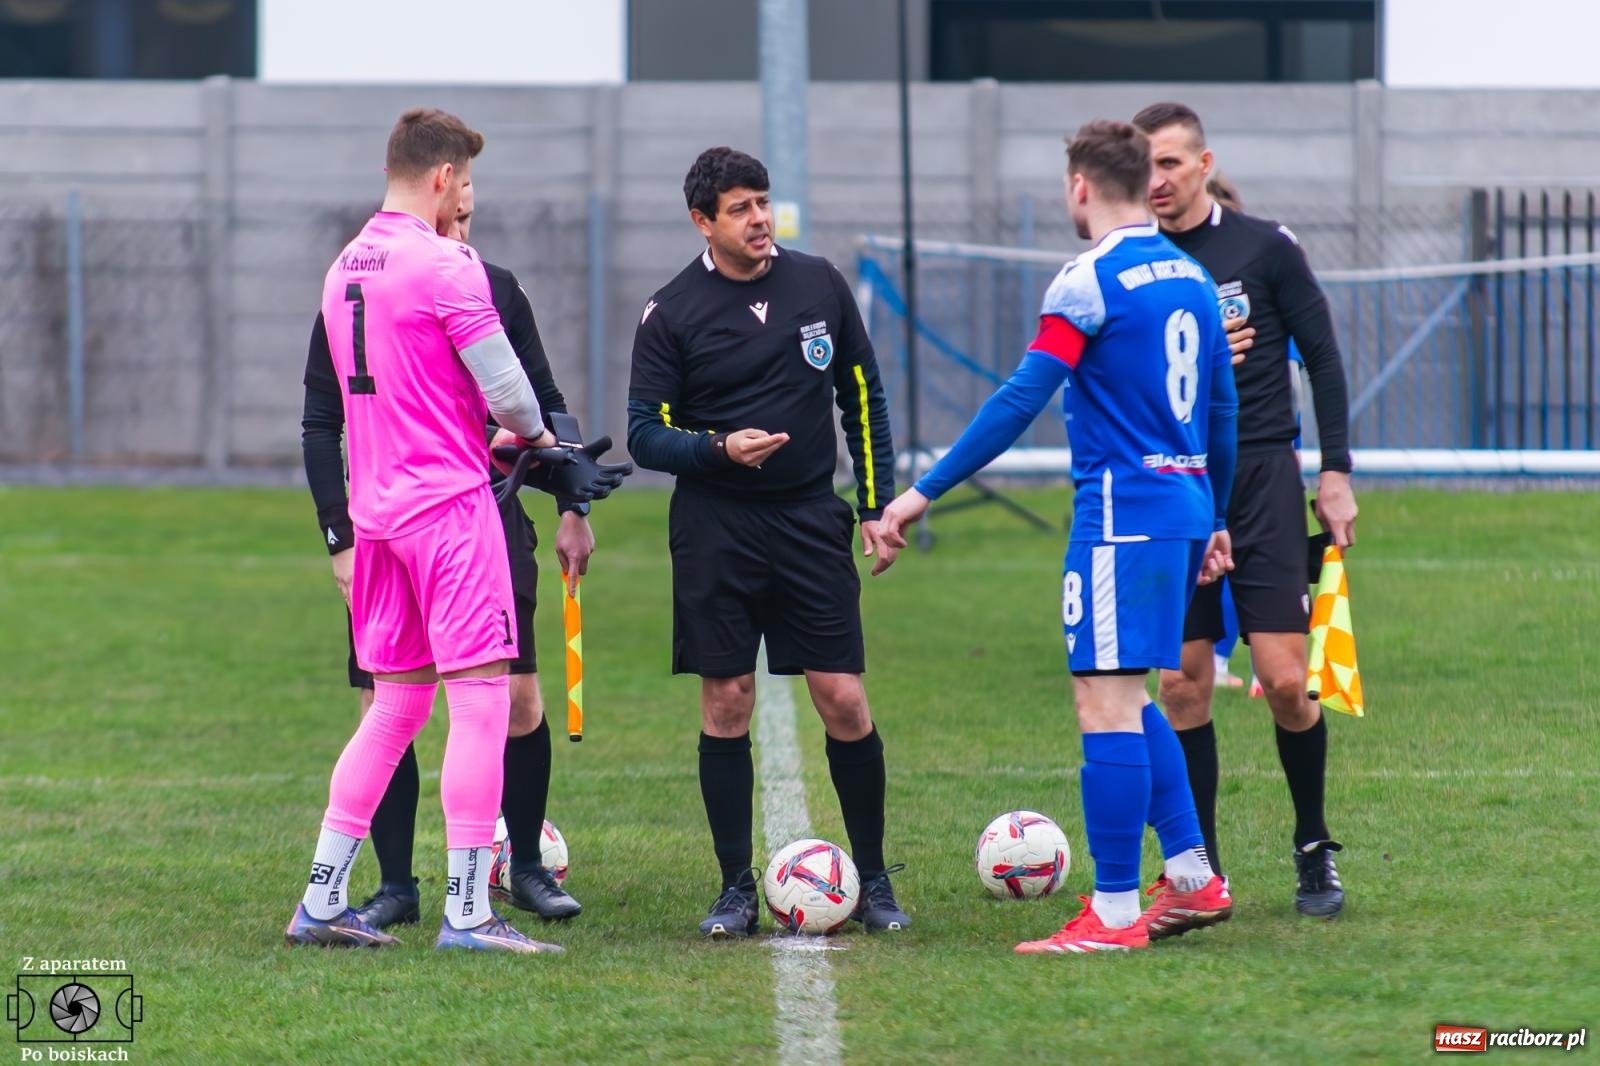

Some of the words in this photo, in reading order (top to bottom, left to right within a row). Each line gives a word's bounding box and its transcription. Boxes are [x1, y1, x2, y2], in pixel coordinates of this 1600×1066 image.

[345, 283, 376, 394] 1
[1165, 308, 1200, 424] 8
[501, 610, 513, 645] 1
[1063, 571, 1083, 626] 8
